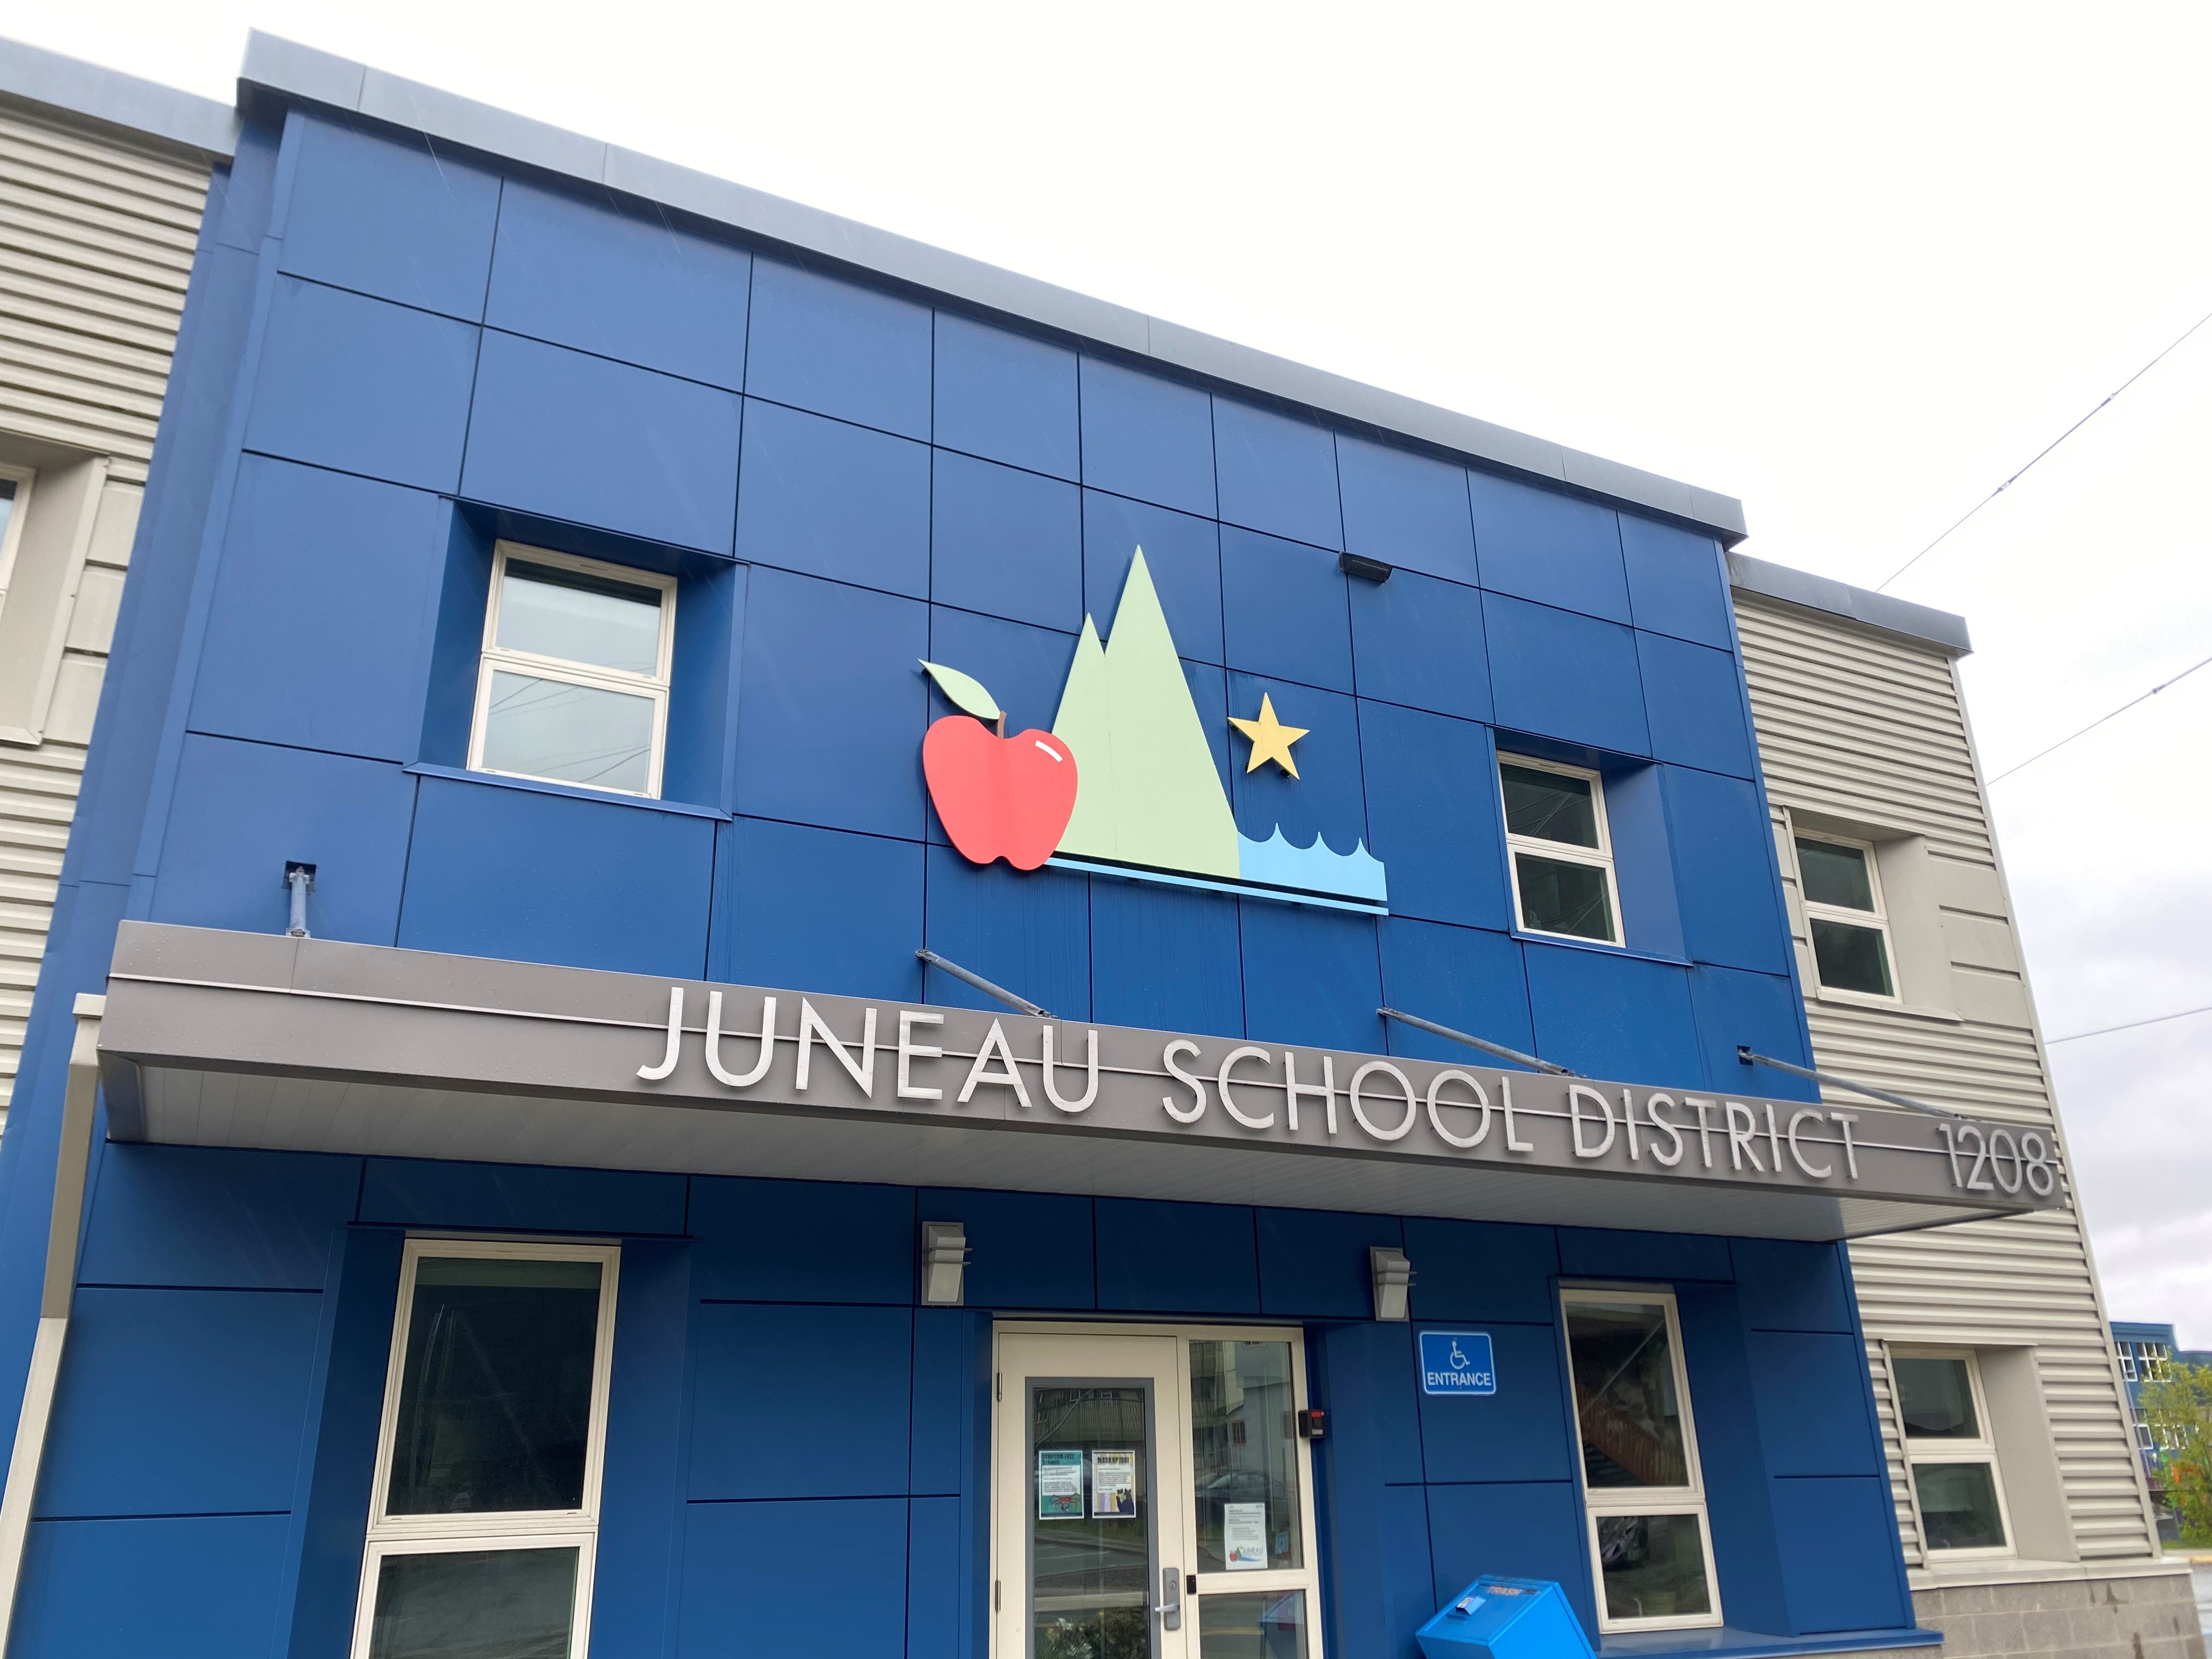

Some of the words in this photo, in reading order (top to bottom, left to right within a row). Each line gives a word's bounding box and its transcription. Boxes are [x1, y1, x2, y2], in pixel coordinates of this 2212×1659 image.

[636, 986, 1099, 1113] JUNEAU
[1162, 1039, 1534, 1152] SCHOOL
[1567, 1084, 1860, 1181] DISTRICT
[1938, 1122, 2055, 1197] 1208
[1427, 1372, 1492, 1386] ENTRANCE
